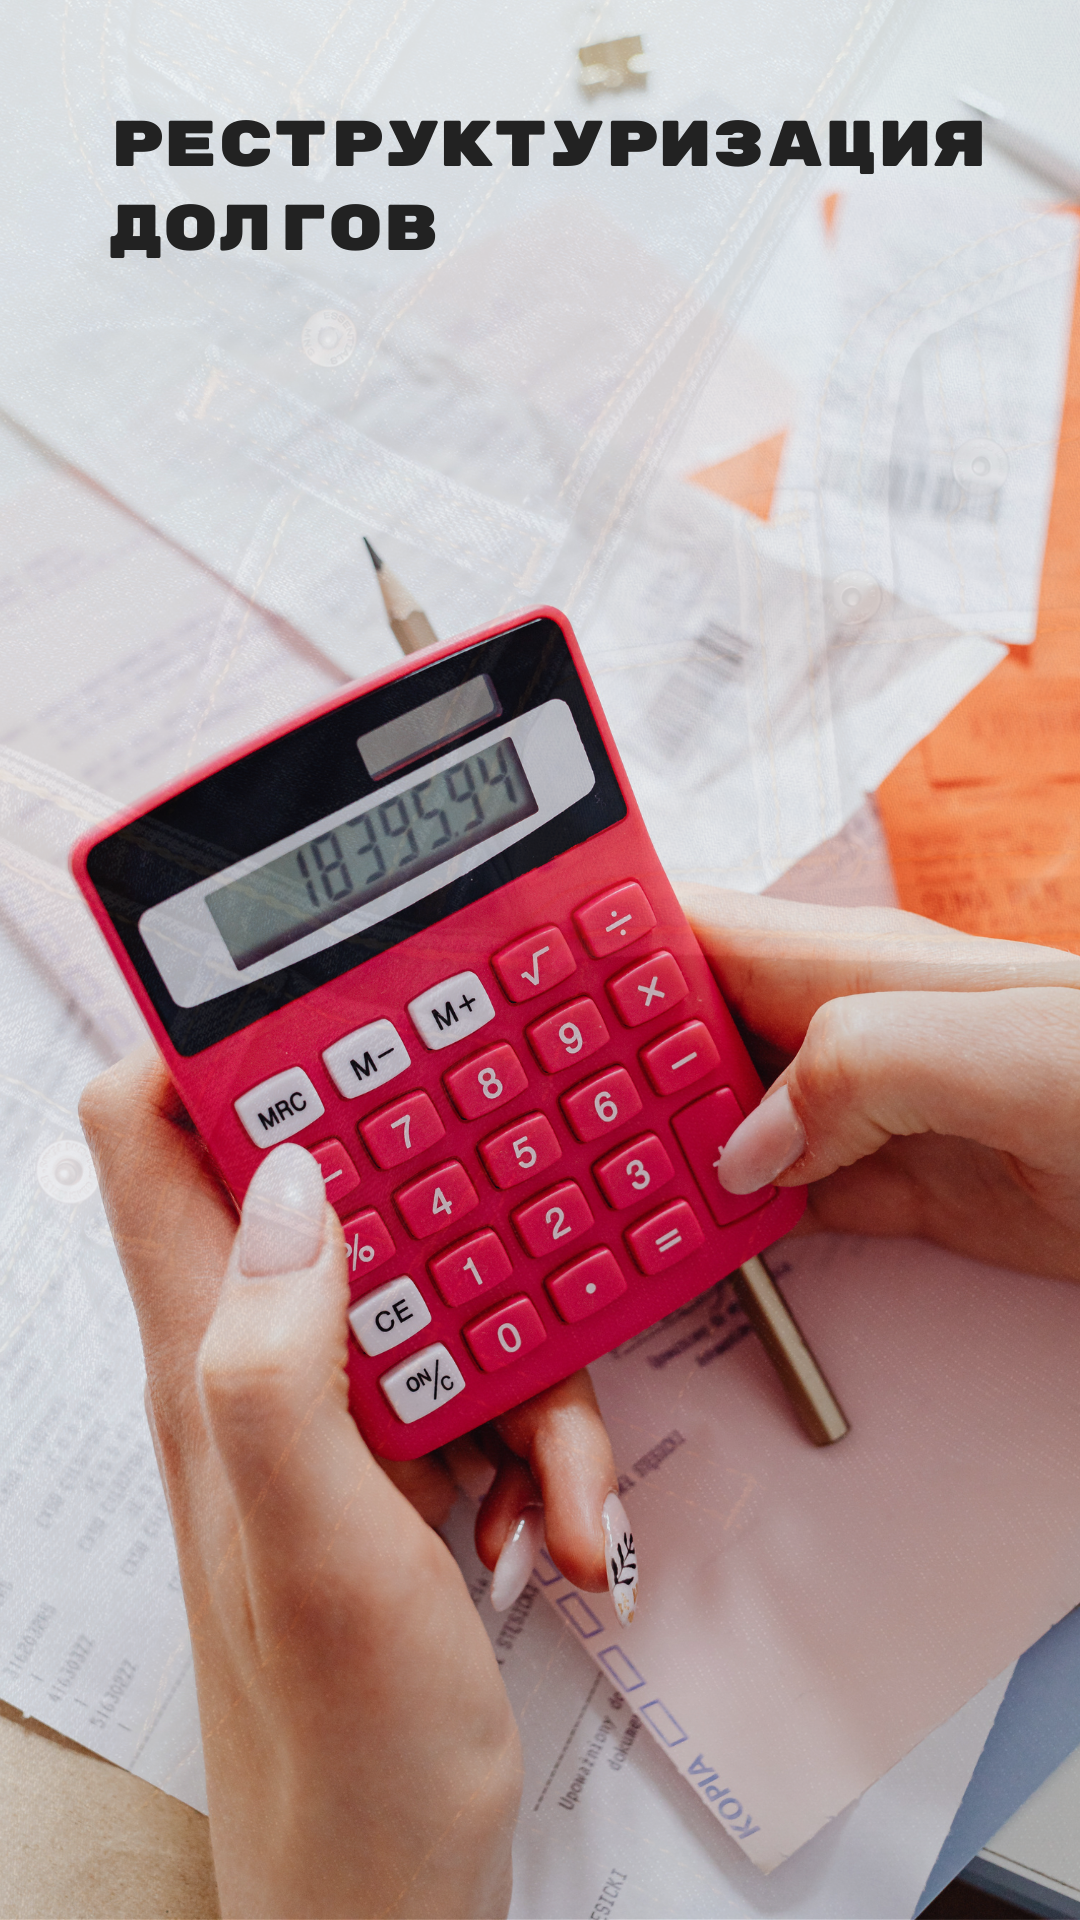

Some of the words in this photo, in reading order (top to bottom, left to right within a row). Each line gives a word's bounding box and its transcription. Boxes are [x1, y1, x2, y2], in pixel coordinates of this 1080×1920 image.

[296, 747, 518, 907] 18395.94
[431, 994, 476, 1031] M+
[558, 1022, 583, 1054] 9
[477, 1067, 503, 1099] 8
[257, 1091, 307, 1131] MRC
[594, 1091, 618, 1123] 6
[390, 1114, 412, 1149] 7
[512, 1136, 538, 1169] 5
[626, 1159, 651, 1190] 3
[431, 1187, 453, 1215] 4
[545, 1207, 572, 1240] 2
[463, 1256, 483, 1286] 1
[375, 1298, 414, 1333] CE
[497, 1322, 522, 1353] 0
[687, 1754, 761, 1839] KOPIA
